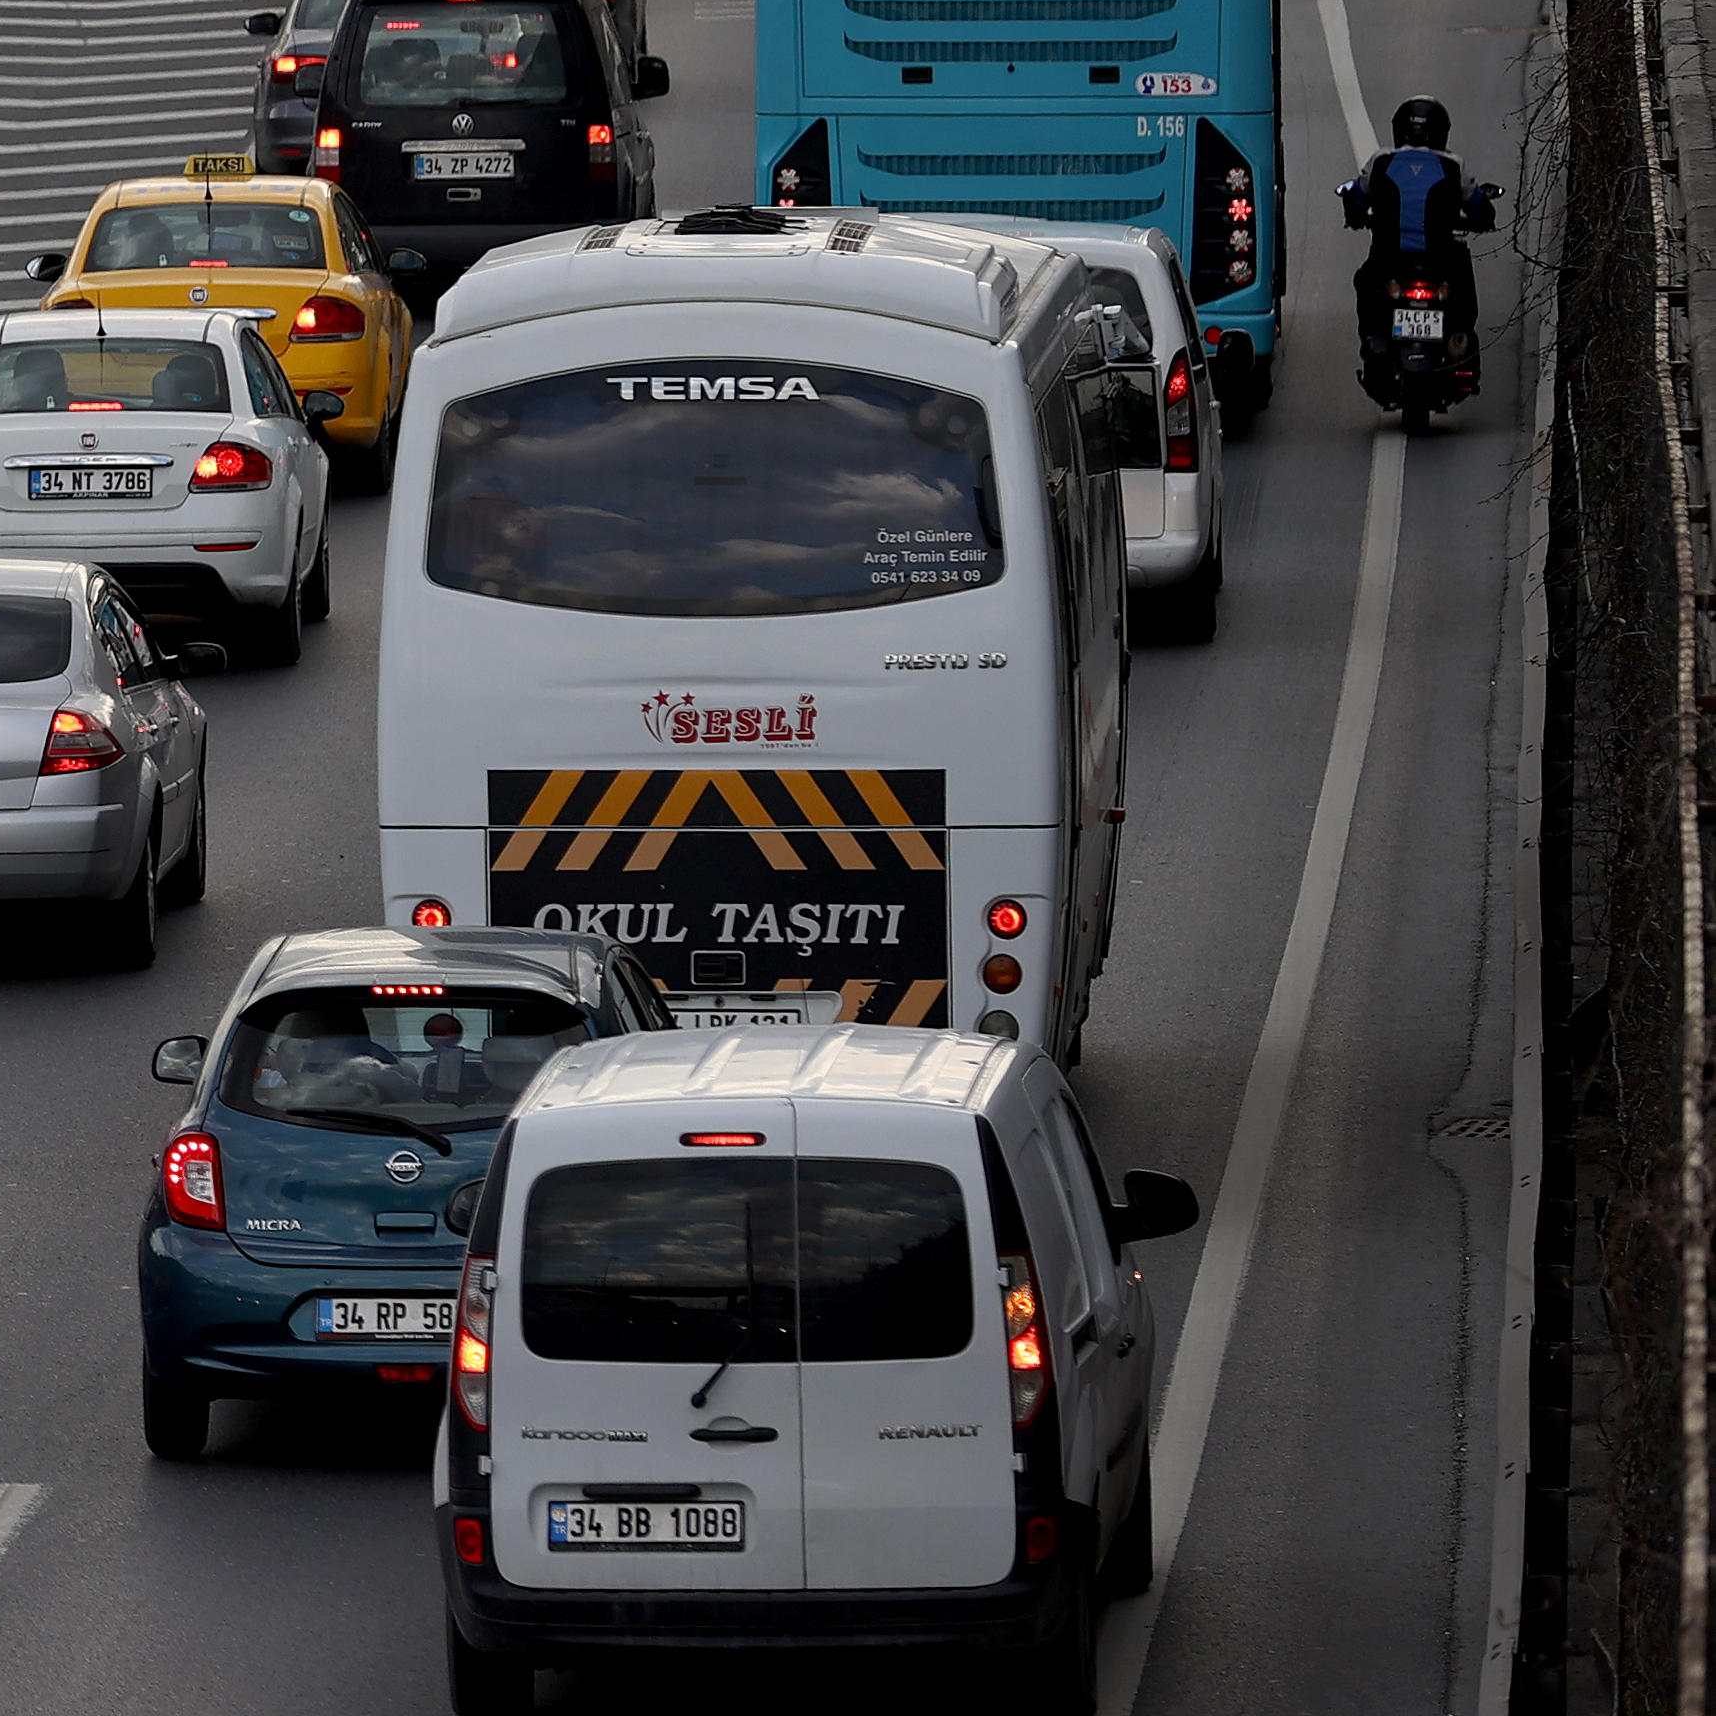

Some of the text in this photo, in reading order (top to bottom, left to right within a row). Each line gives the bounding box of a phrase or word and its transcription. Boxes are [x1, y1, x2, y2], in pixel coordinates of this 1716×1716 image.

[1162, 79, 1192, 94] 153
[1157, 115, 1185, 138] 156
[425, 157, 512, 175] 34 ZP 4272
[605, 376, 821, 401] TEMSA
[41, 471, 147, 491] 34 NT 3786
[877, 528, 974, 544] Özel Günlere
[864, 548, 989, 567] Araç Temin Edilir
[871, 569, 981, 584] 0541 623 34 09
[977, 652, 1008, 670] SD
[533, 903, 906, 957] OKUL TAŞITI
[245, 1217, 302, 1232] MICRA
[335, 1302, 365, 1330] 34
[376, 1302, 407, 1330] RP
[878, 1422, 983, 1440] RENAULT
[554, 1507, 738, 1538] TR 34 BB 1088
